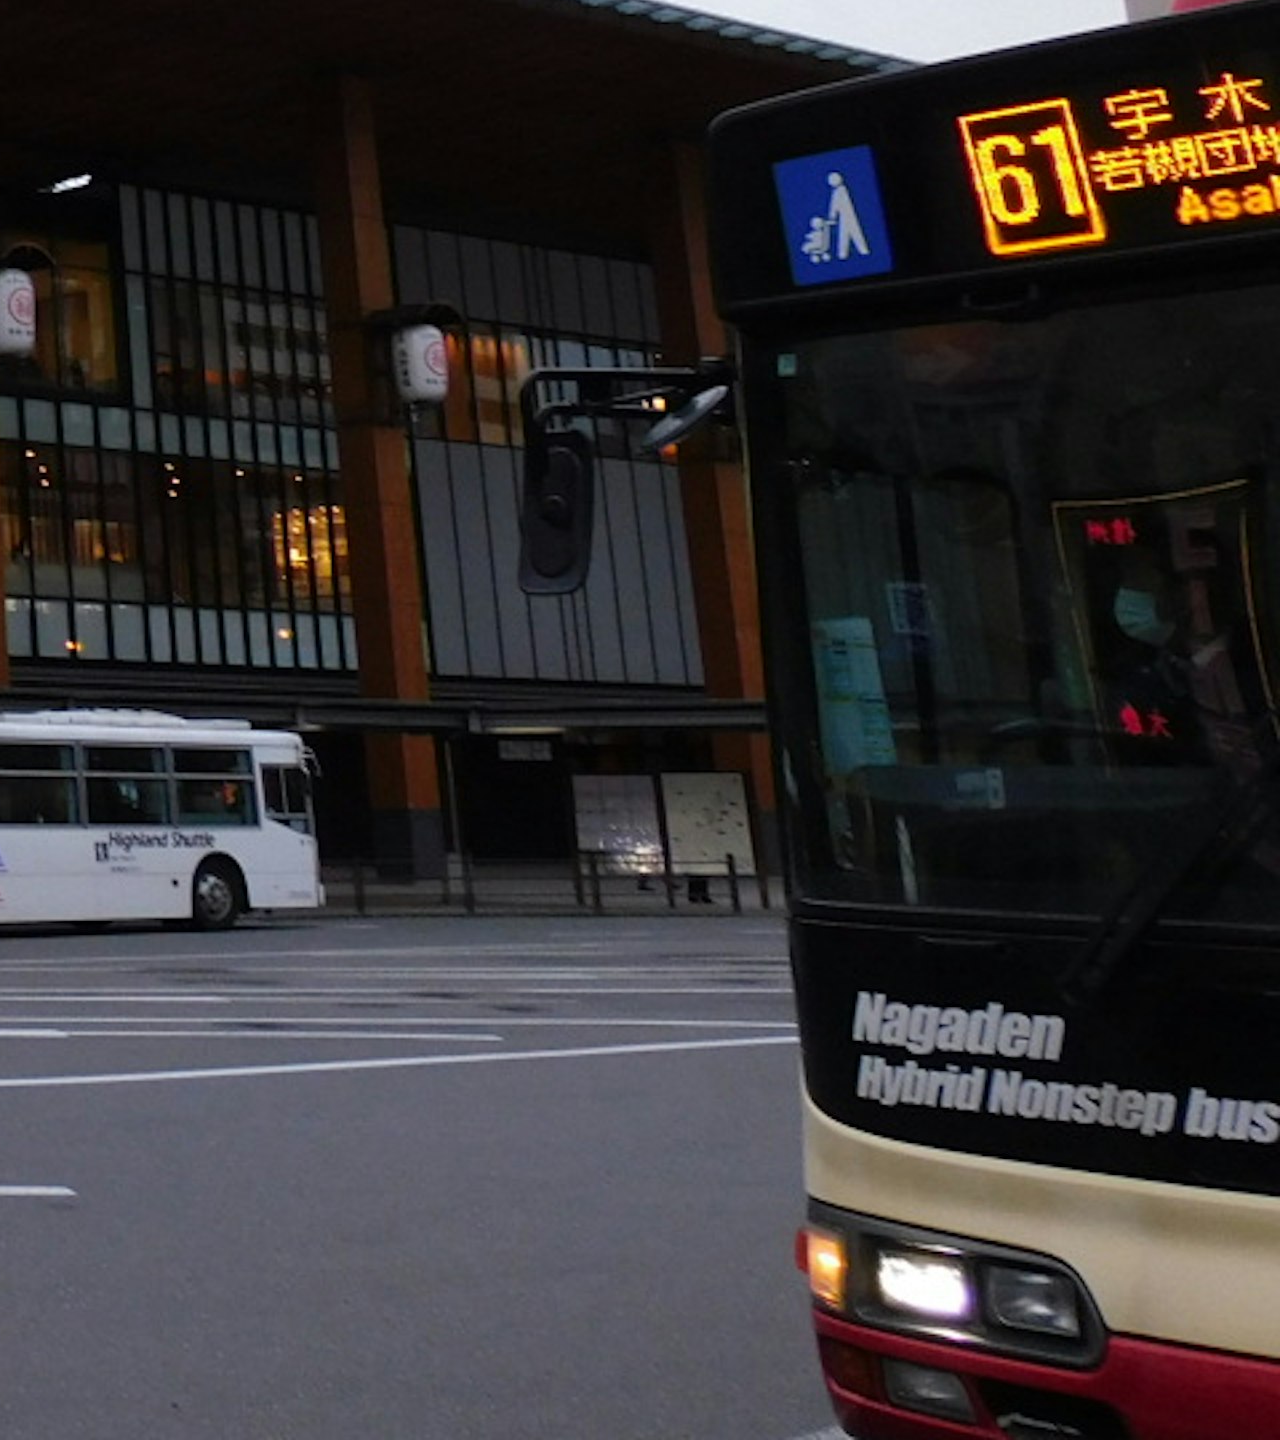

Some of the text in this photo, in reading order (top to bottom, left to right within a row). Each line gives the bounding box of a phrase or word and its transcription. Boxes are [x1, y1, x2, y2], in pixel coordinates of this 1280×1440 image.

[1102, 72, 1271, 140] 宇木
[975, 126, 1086, 225] 61
[109, 831, 215, 853] Highland Shuttle
[852, 991, 1066, 1062] Nagaden
[856, 1055, 1280, 1144] Hybrid Nonstep bus
